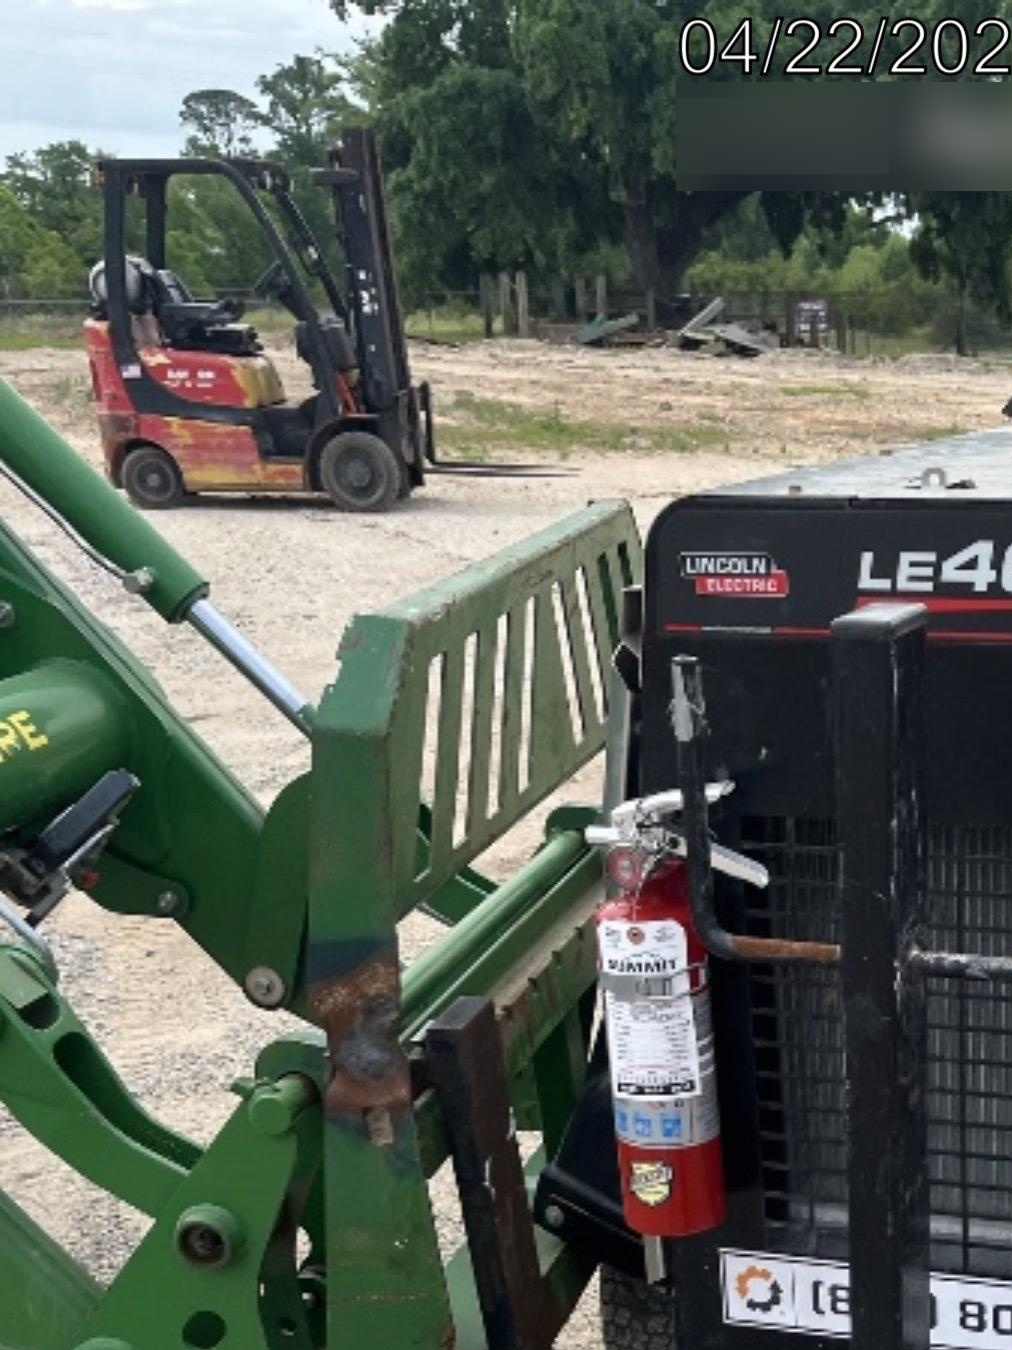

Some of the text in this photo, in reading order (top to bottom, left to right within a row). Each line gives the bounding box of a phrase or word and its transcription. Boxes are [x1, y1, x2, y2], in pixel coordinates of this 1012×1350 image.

[686, 557, 766, 574] LINCOLN
[706, 578, 777, 592] ELECTRIC
[608, 958, 676, 973] SUMMIT
[812, 1279, 938, 1330] (8)
